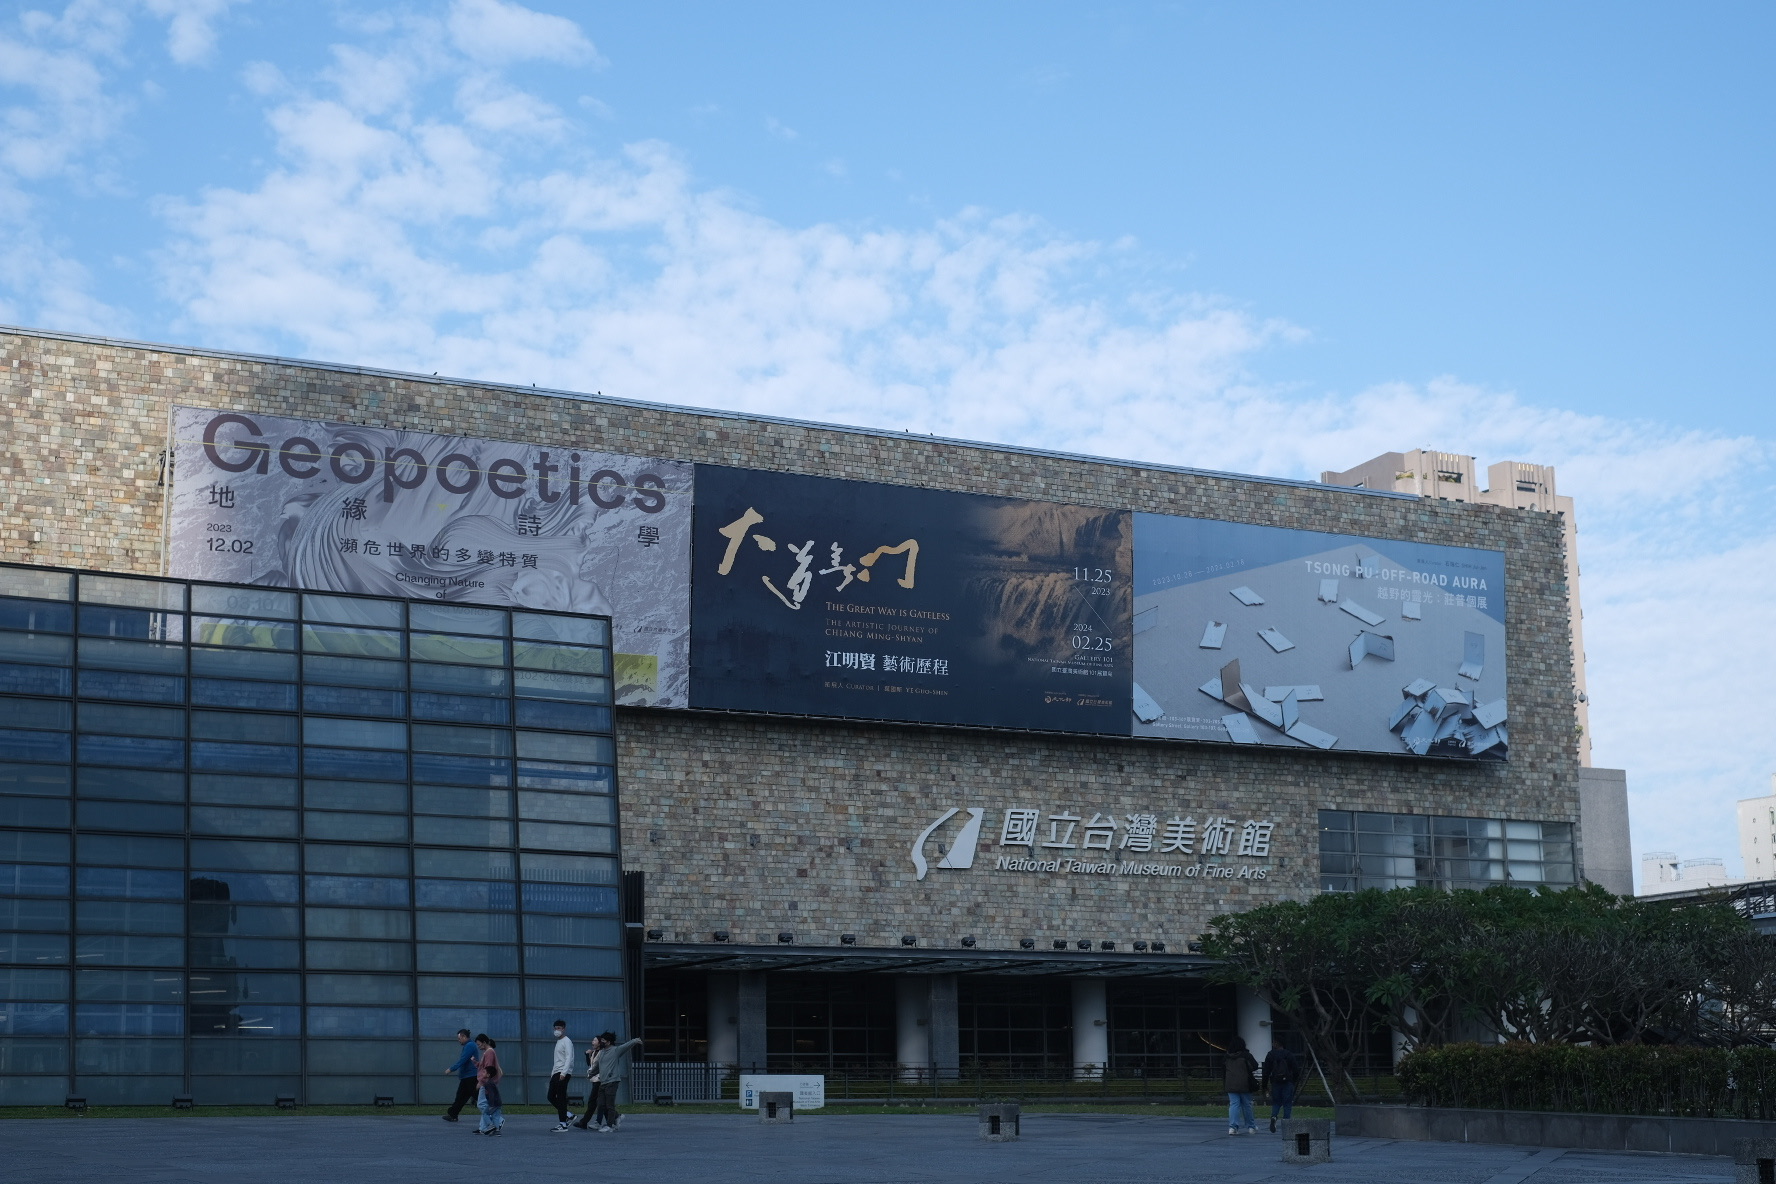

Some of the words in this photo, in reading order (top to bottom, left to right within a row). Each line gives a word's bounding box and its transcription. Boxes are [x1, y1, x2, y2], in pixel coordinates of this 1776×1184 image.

[203, 413, 667, 514] Geopoetics
[207, 485, 235, 509] 地
[341, 496, 368, 521] 緣
[517, 513, 542, 537] 詩
[637, 525, 660, 548] 學
[207, 523, 232, 533] 2023
[206, 537, 254, 554] 12.02
[339, 537, 540, 570] 瀕危世界的多變特質
[395, 572, 447, 588] Changing
[449, 573, 486, 589] Nature
[1073, 566, 1112, 583] 11.25
[1305, 560, 1350, 577] TSONG
[1453, 575, 1488, 591] AURA
[435, 590, 448, 600] of
[1091, 586, 1111, 596] 2023
[227, 595, 273, 612] 03.10
[826, 601, 845, 612] THE
[847, 603, 876, 614] GREAT
[878, 606, 897, 616] WAY
[899, 609, 907, 617] IS
[909, 609, 950, 621] GATELESS
[826, 617, 842, 627] THE
[845, 620, 884, 630] ARTISTIC
[887, 623, 925, 633] JOURNEY
[928, 627, 939, 635] OF
[1073, 623, 1093, 632] 2024
[825, 628, 863, 639] CHIANG
[866, 632, 923, 643] MING-SHYAN
[1072, 635, 1112, 651] 02.25
[825, 650, 876, 670] 江明賢
[882, 654, 949, 676] 藝術歷程
[999, 808, 1275, 858] 國立台灣美術館
[995, 855, 1060, 873] National
[1064, 857, 1116, 874] Taiwan
[1119, 859, 1182, 877] Museum
[1185, 862, 1201, 877] of
[1202, 863, 1234, 879] Fine
[1237, 865, 1267, 880] Arts
